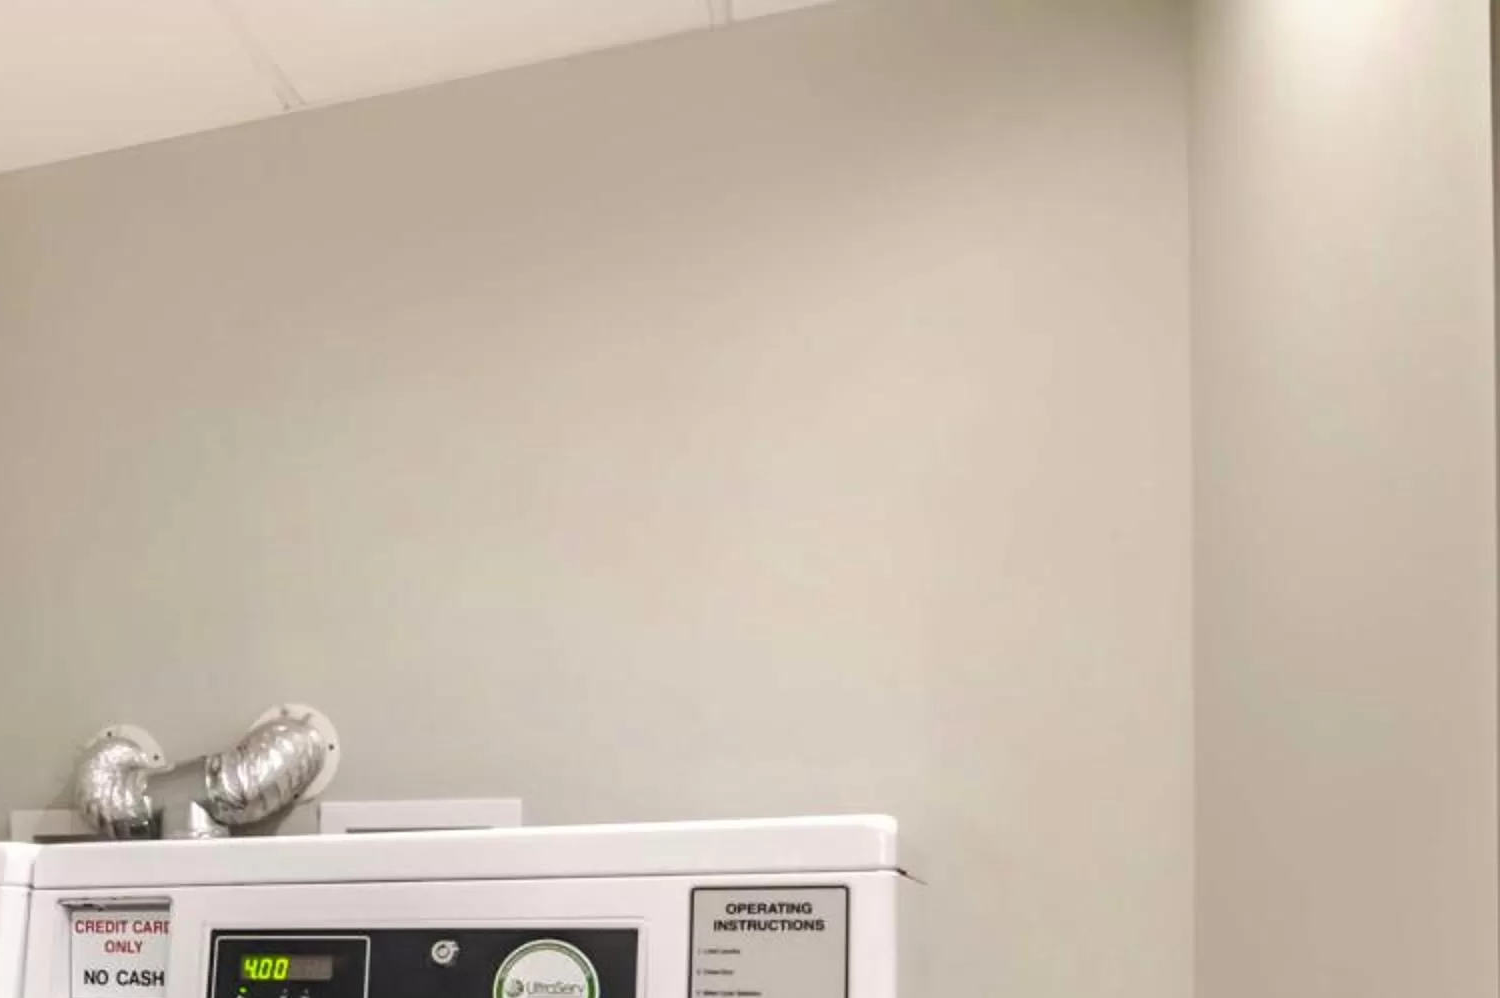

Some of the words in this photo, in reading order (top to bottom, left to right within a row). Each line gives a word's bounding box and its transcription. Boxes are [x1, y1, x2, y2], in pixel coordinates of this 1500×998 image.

[725, 902, 813, 915] OPERATING
[75, 920, 128, 934] CREDIT
[713, 919, 826, 932] INSTRUCTIONS
[104, 940, 143, 953] ONLY
[83, 969, 109, 986] NO
[115, 970, 165, 987] CASH
